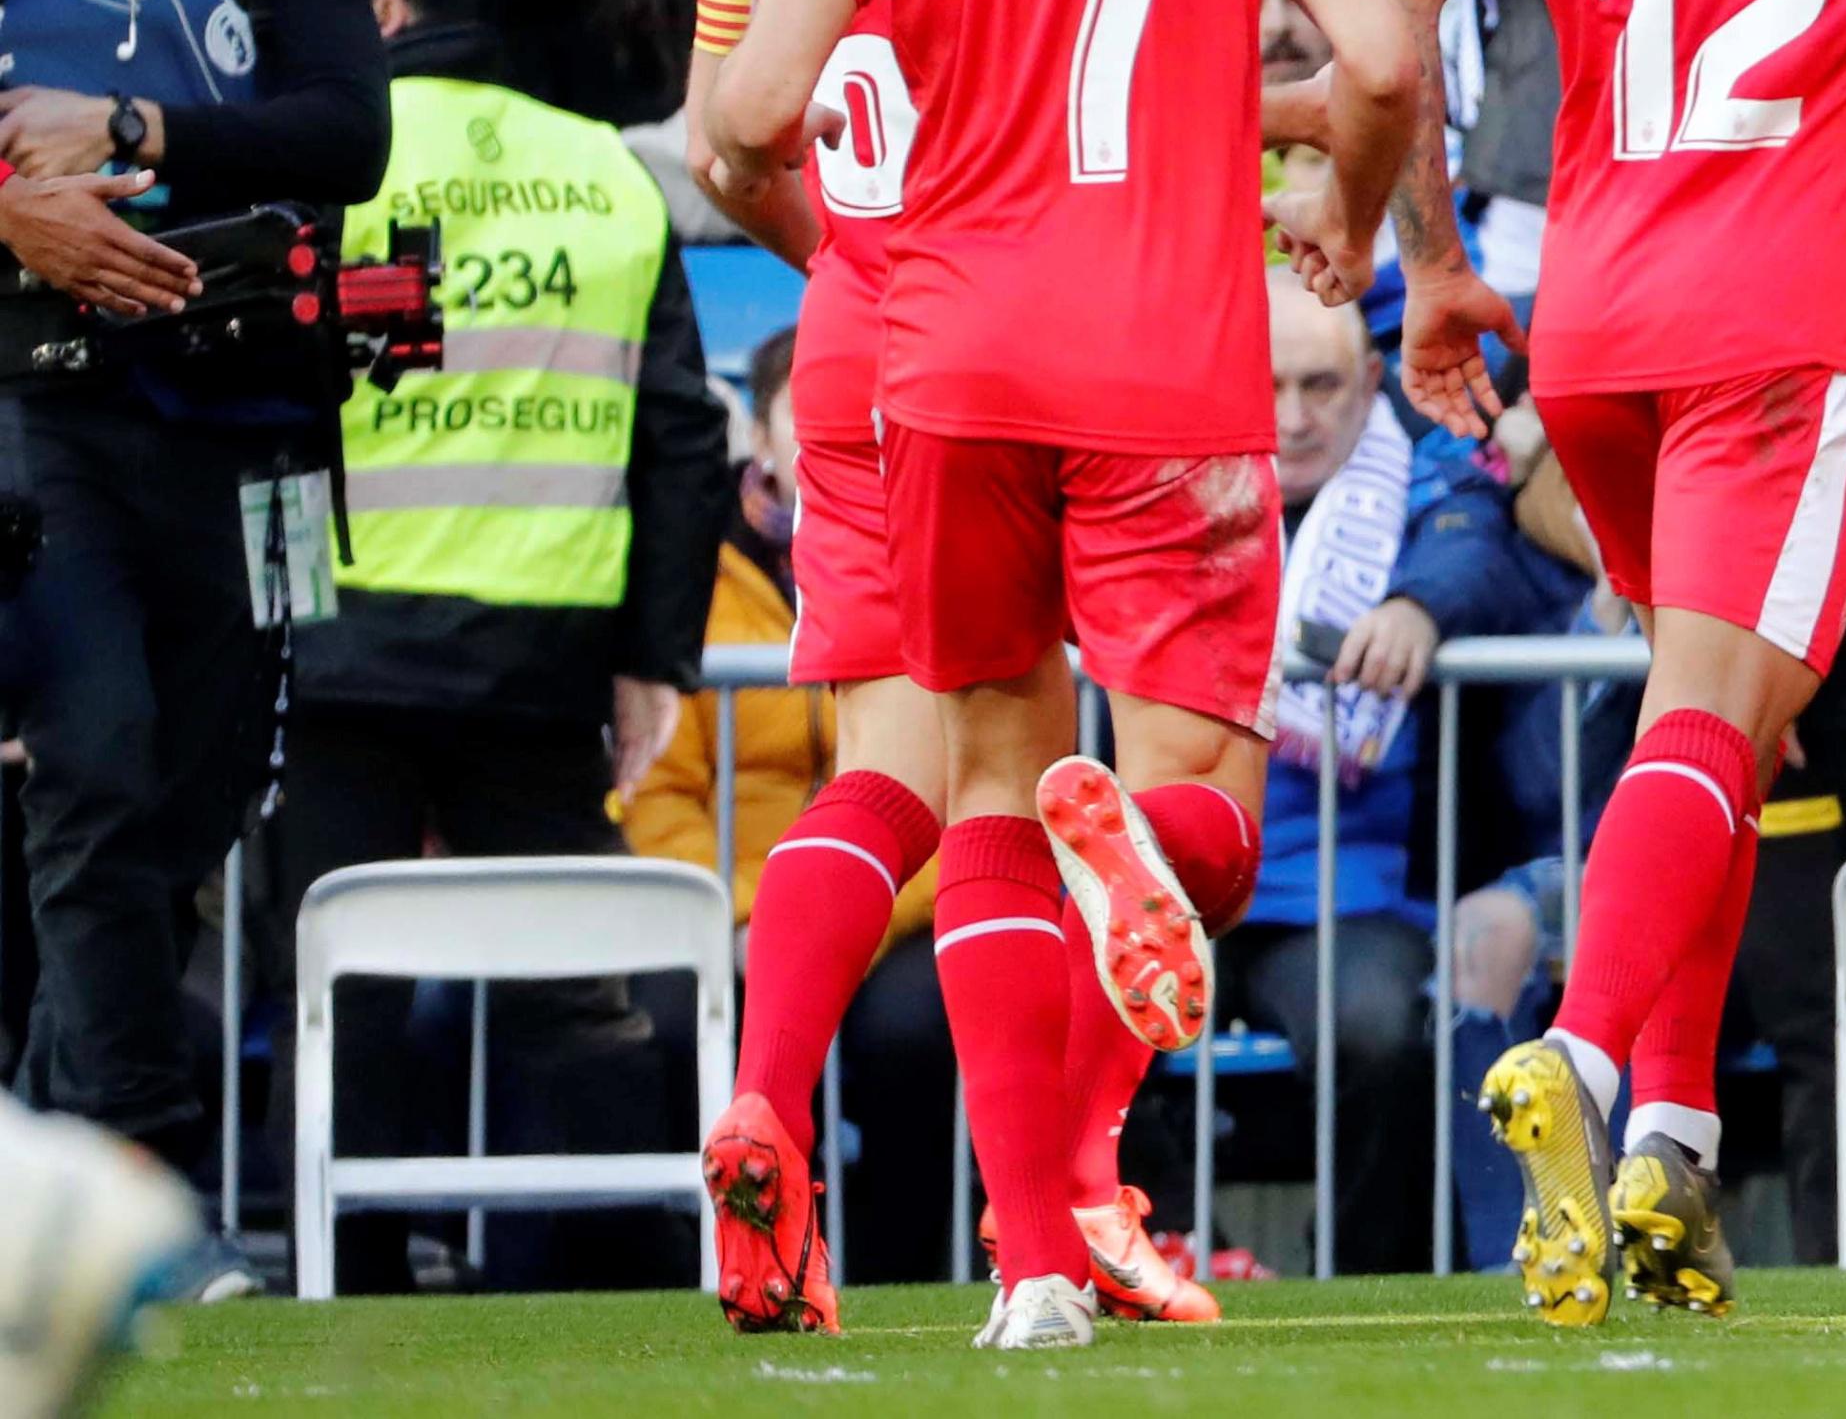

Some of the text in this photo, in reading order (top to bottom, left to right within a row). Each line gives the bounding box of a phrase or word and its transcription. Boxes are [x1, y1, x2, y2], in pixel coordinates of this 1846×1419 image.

[390, 177, 613, 218] SEGURIDAD
[454, 245, 578, 311] 234
[374, 395, 625, 432] PROSEGUR
